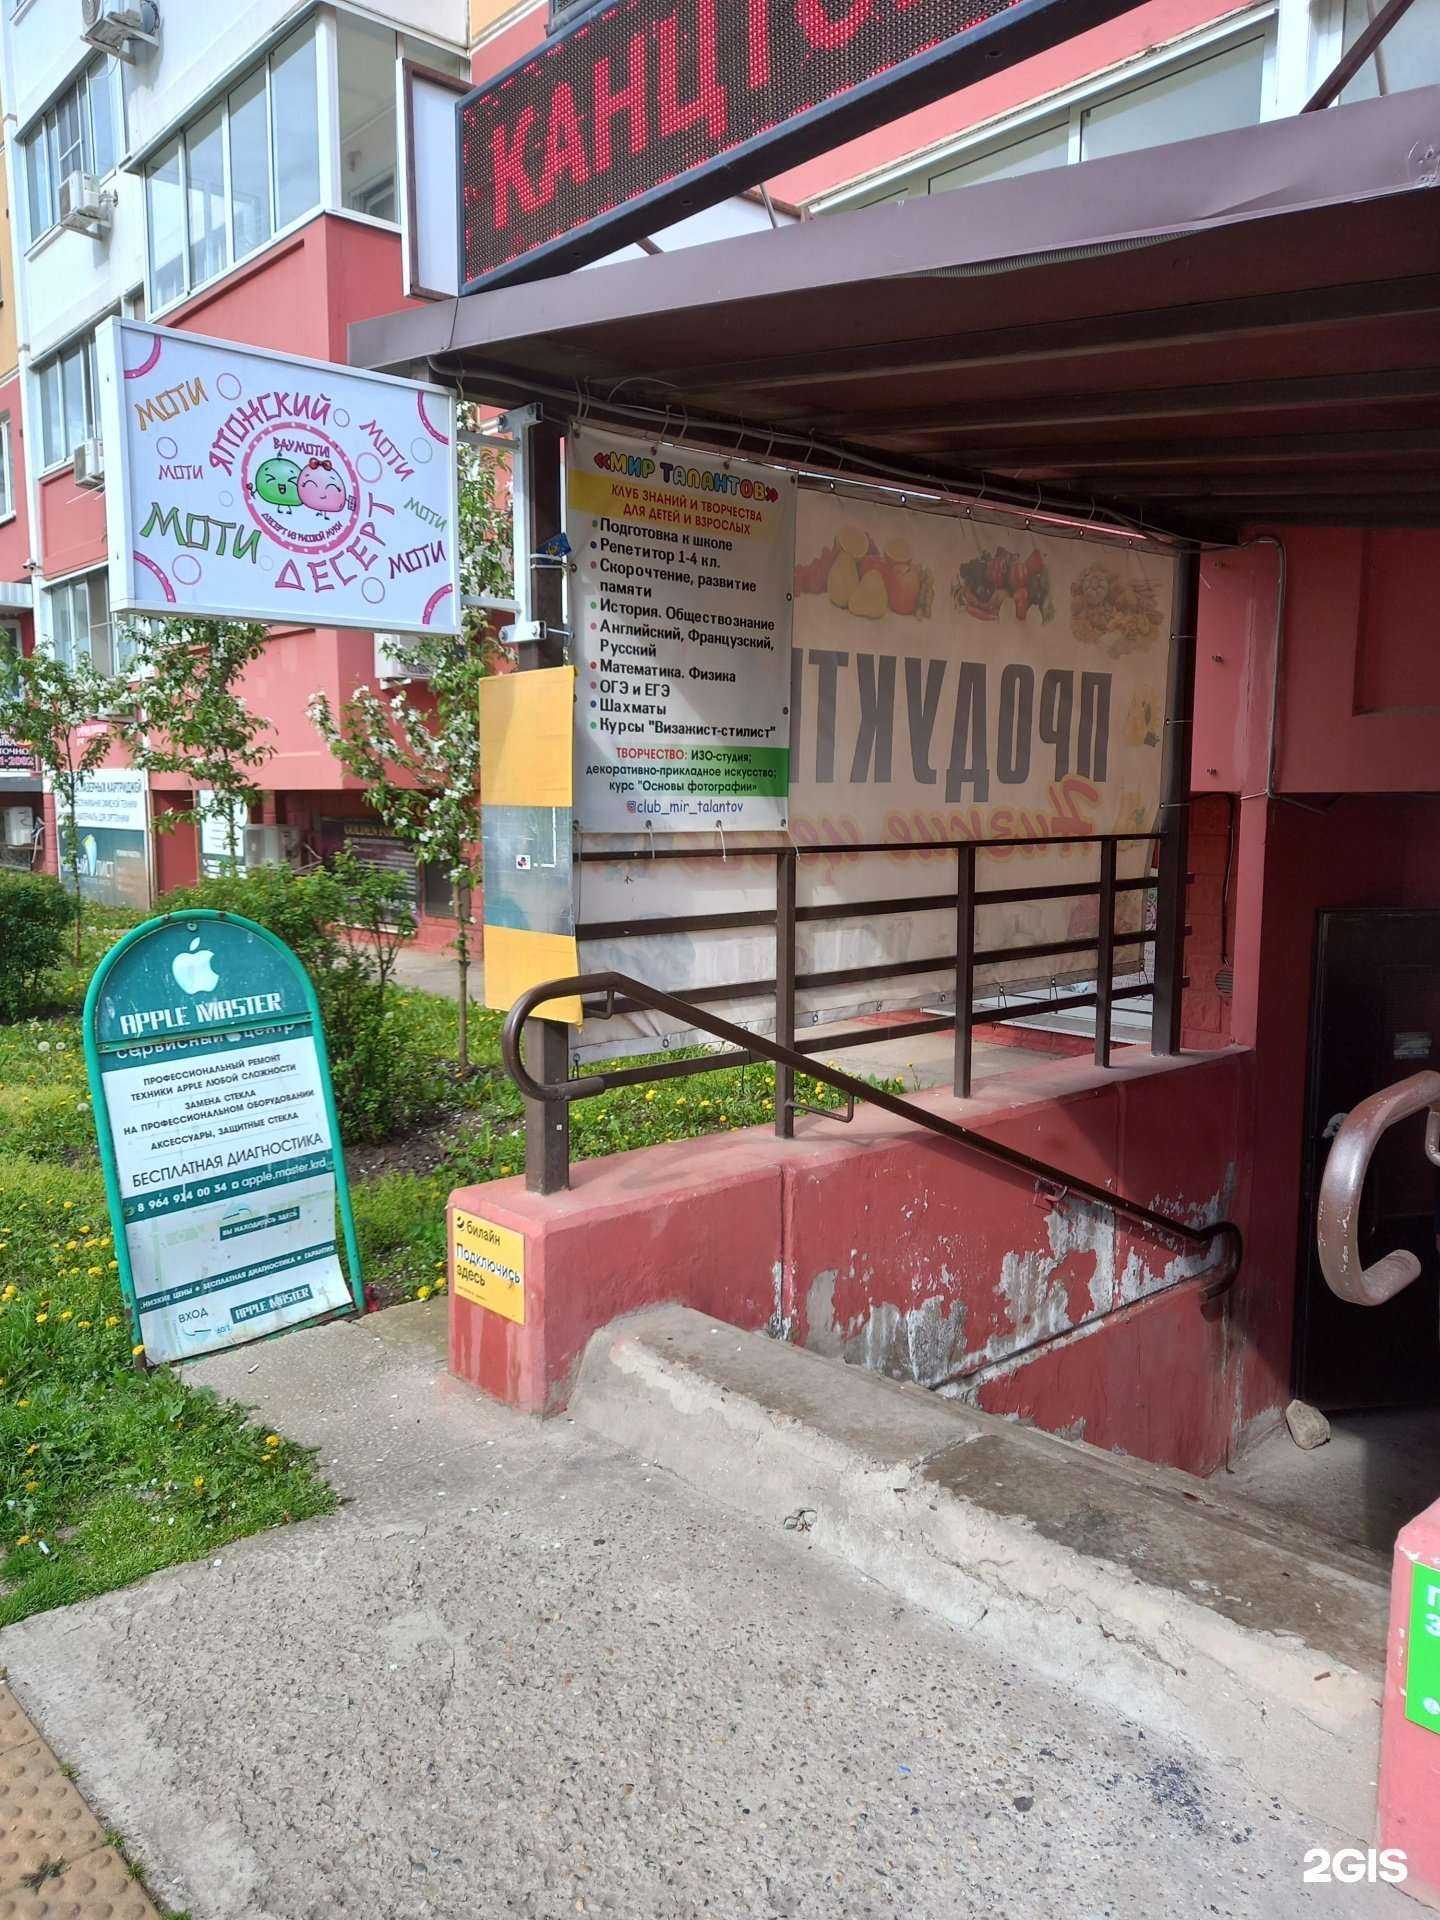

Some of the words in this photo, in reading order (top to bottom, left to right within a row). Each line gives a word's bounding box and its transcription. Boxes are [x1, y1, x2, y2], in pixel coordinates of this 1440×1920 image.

[134, 377, 208, 431] МОТИ
[209, 391, 331, 476] ЯПОНСКИЙ
[360, 419, 414, 482] МОТИ
[159, 465, 203, 480] МОТИ
[403, 496, 447, 532] МОТИ
[612, 484, 639, 500] КЛУБ
[643, 487, 687, 509] ЗНАНИЙ
[690, 497, 698, 509] И
[701, 500, 762, 522] ТВОРЧЕСТВА
[140, 502, 261, 564] МОТИ
[601, 518, 678, 542] Подготовка
[683, 534, 690, 545] к
[693, 534, 732, 552] школе
[623, 504, 646, 517] ДЛЯ
[649, 507, 680, 523] ДЕТЕЙ
[684, 513, 691, 524] И
[695, 515, 751, 535] ВЗРОСЛЫХ
[275, 493, 395, 593] ДЕСЕРТ
[601, 538, 674, 563] Репетитор
[679, 549, 697, 564] 1-4
[701, 554, 720, 568] кл.
[389, 540, 446, 579] МОТИ
[600, 559, 694, 585] Скорочтение,
[698, 575, 757, 592] развитие
[600, 582, 652, 597] памяти
[601, 598, 661, 619] История.
[666, 607, 775, 631] Обществознание
[600, 619, 684, 642] Английский,
[688, 629, 774, 651] Французский,
[600, 639, 656, 657] Русский
[600, 659, 685, 679] Математика.
[689, 667, 736, 683] Физика
[600, 680, 628, 695] ОГЭ
[633, 686, 640, 696] и
[645, 683, 670, 698] ЕГЭ
[600, 699, 666, 715] Шахматы
[600, 718, 644, 735] Курсы
[649, 721, 776, 738] "Визажист-стилист"
[616, 747, 688, 761] ТВОРЧЕСТВО:
[691, 751, 752, 763] ИЗО-студия;
[586, 765, 721, 777] декоративно-прикладное
[724, 768, 777, 779] искусство;
[609, 782, 634, 792] курс
[638, 780, 684, 792] "Основы
[120, 1006, 191, 1035] APPLE
[196, 992, 281, 1023] MASTER
[131, 1087, 173, 1102] ТЕХНИКИ
[177, 1082, 202, 1093] APPLE
[205, 1073, 239, 1088] ЛЮБОЙ
[241, 1064, 297, 1079] СЛОЖНОСТИ
[143, 1060, 245, 1086] ПРОФЕССИОНАЛЬНЫЙ
[248, 1054, 281, 1067] РЕМОНТ
[123, 1126, 138, 1136] НА
[141, 1103, 244, 1132] ПРОФЕССИОНАЛЬНОМ
[247, 1089, 315, 1110] ОБОРУДОВАНИИ
[185, 1097, 220, 1110] ЗАМЕНА
[224, 1090, 256, 1102] СТЕКЛА
[151, 1130, 215, 1151] АКСЕССУАРЫ,
[218, 1119, 265, 1135] ЗАЩИТНЫЕ
[268, 1111, 299, 1125] СТЕКЛА
[132, 1157, 224, 1188] БЕСПЛАТНАЯ
[227, 1132, 323, 1167] ДИАГНОСТИКА
[137, 1202, 145, 1213] 8
[148, 1196, 169, 1210] 964
[197, 1187, 210, 1198] 00
[240, 1158, 326, 1191] apple.master.krd
[467, 1221, 501, 1246] билайн
[203, 1272, 247, 1289] БЕСПЛАТНАЯ
[249, 1257, 295, 1277] ДИАГНОСТИКА
[457, 1243, 520, 1283] Подключись
[457, 1265, 485, 1286] здесь
[178, 1307, 208, 1323] ВХОД
[235, 1301, 265, 1320] APPLE
